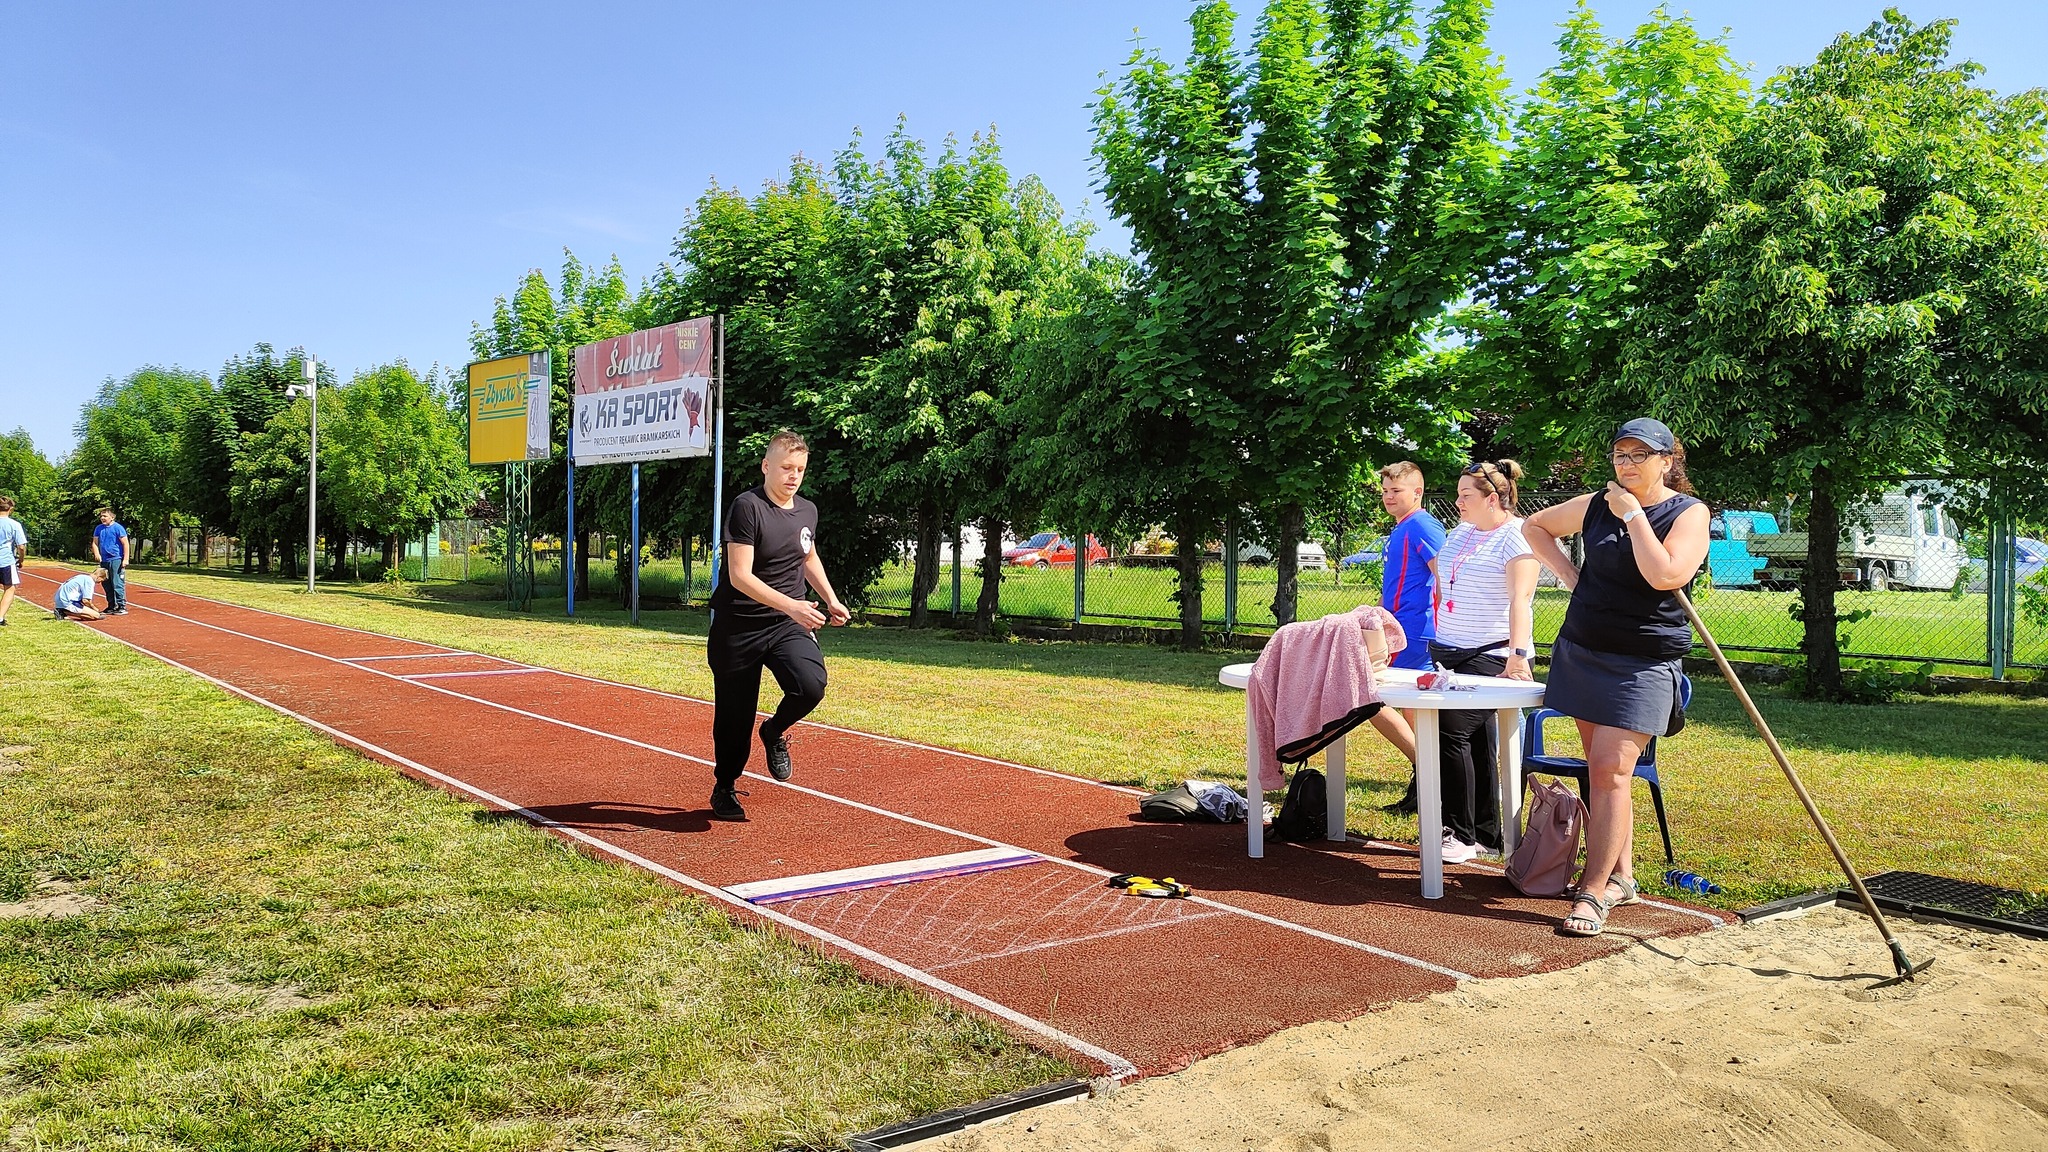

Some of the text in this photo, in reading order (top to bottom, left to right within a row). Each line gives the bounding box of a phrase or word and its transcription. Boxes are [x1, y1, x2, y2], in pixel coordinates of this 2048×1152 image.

[677, 327, 699, 338] NISKIE
[679, 339, 697, 350] CENY
[606, 341, 663, 377] Świat
[595, 387, 683, 429] KR SPORT
[594, 436, 619, 447] PRODUCENT
